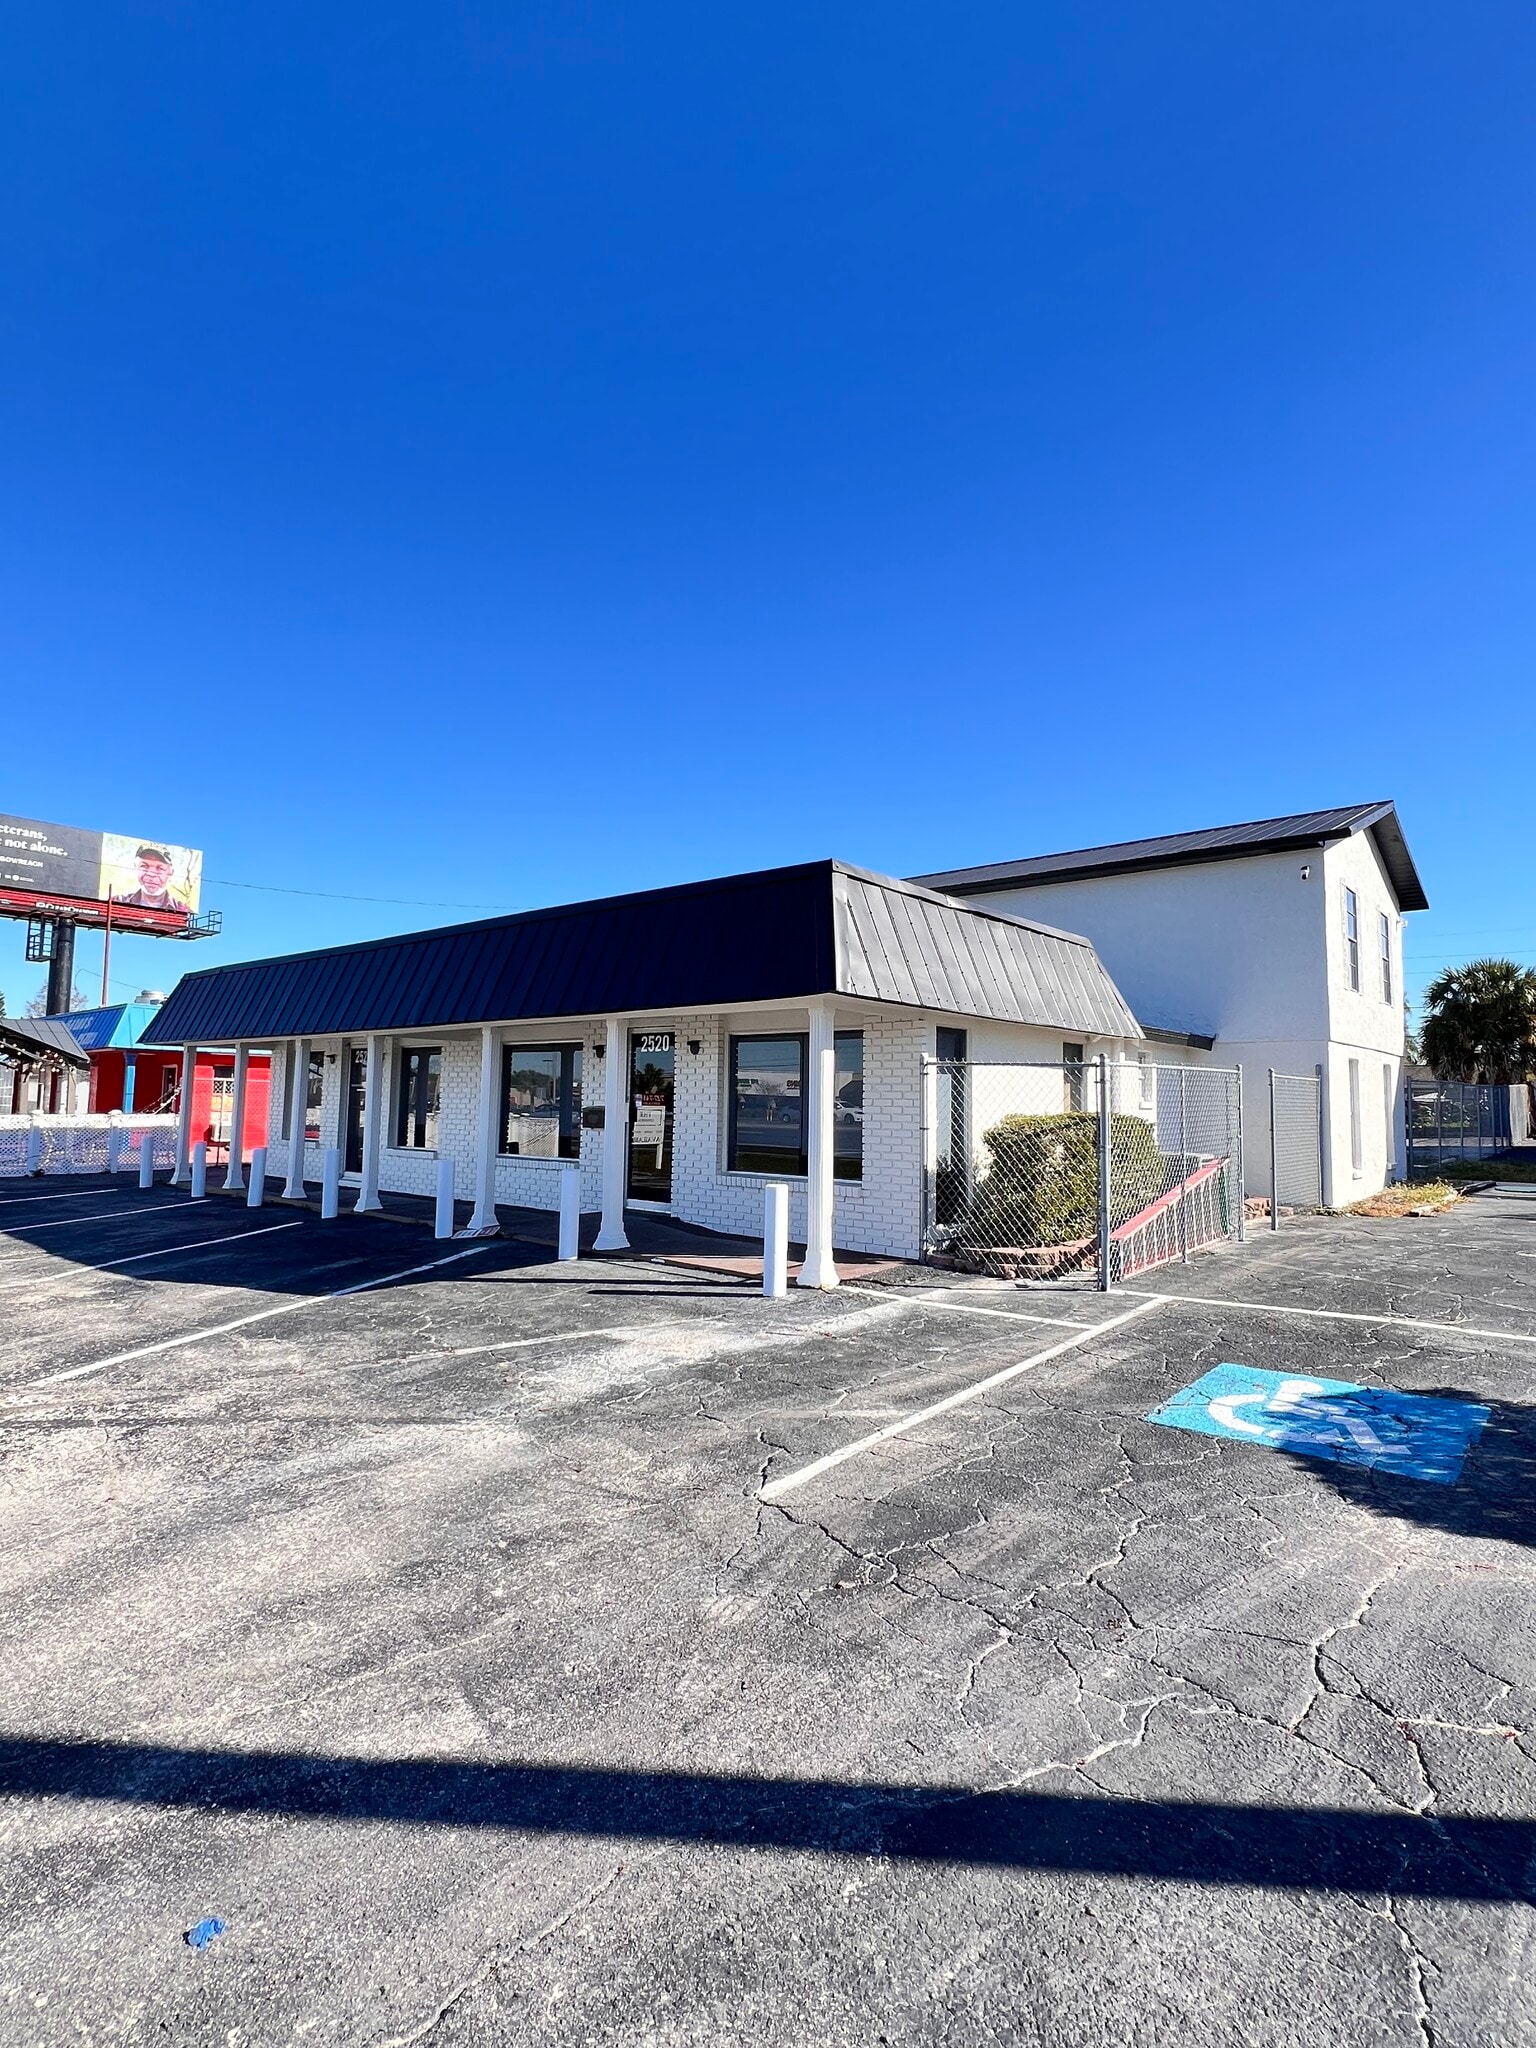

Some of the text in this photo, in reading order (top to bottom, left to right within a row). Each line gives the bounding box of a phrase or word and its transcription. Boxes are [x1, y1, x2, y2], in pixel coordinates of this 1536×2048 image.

[5, 839, 28, 849] not
[30, 841, 69, 857] alone.
[640, 1034, 670, 1053] 2520
[355, 1050, 368, 1065] 252
